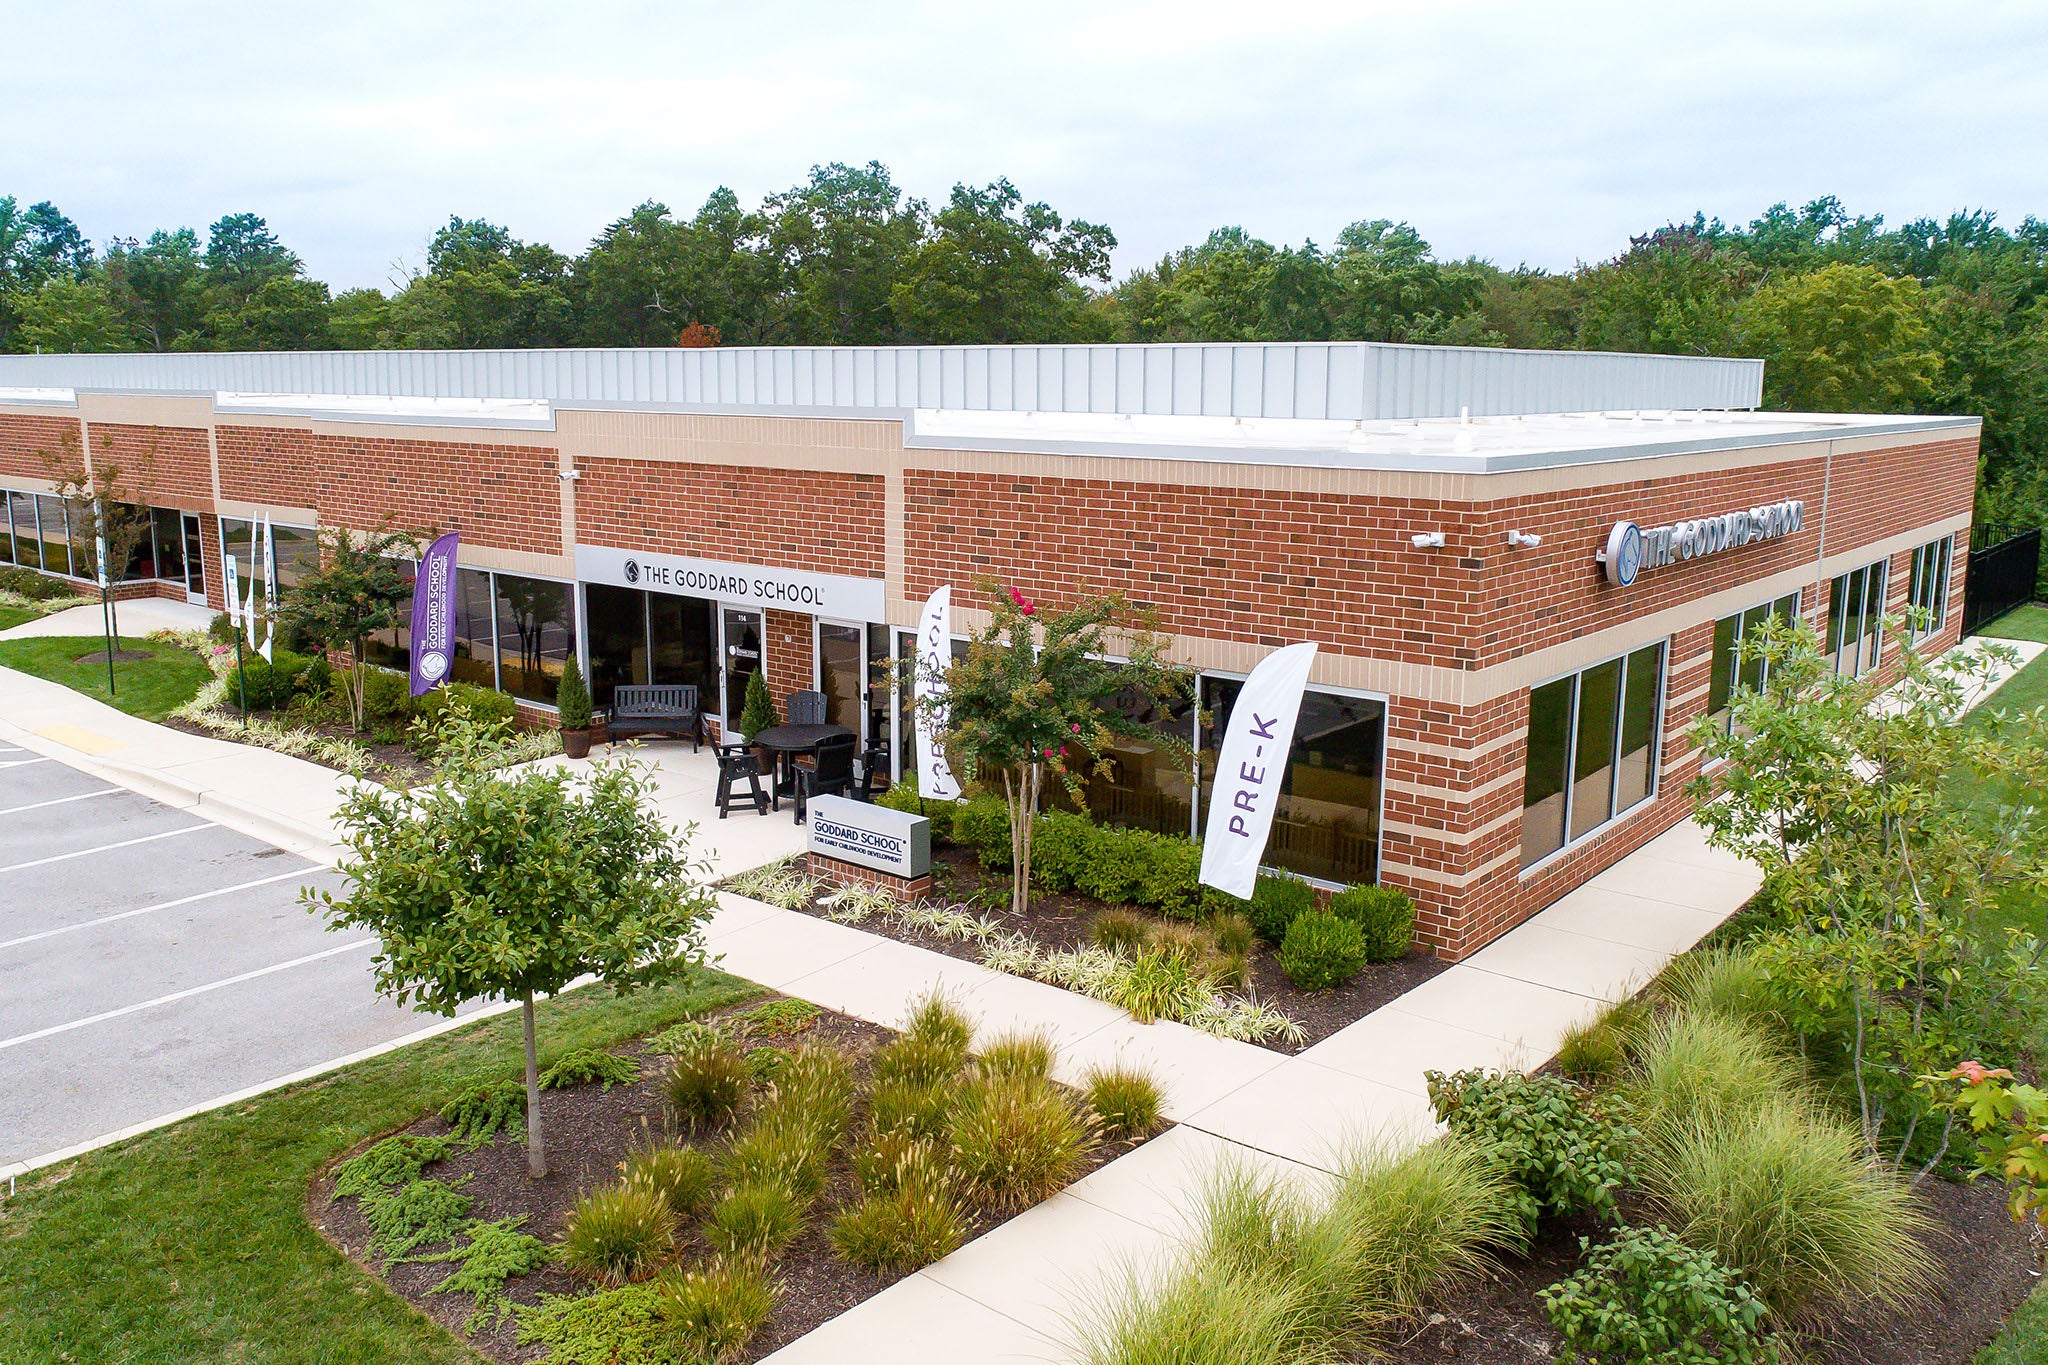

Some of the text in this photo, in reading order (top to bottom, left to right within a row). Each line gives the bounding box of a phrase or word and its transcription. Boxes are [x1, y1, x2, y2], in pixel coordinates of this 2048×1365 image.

[1643, 500, 1804, 569] THE GODDARD SCHOOL
[428, 555, 441, 649] GODDARD SCHOOL
[644, 565, 824, 606] THE GODDARD SCHOOL
[1229, 712, 1278, 838] PRE-K
[815, 821, 902, 853] GODDARD SCHOOL
[825, 837, 838, 847] EARLY
[839, 841, 866, 854] CHILDHOOD
[867, 850, 902, 863] DEVELOPMENT
